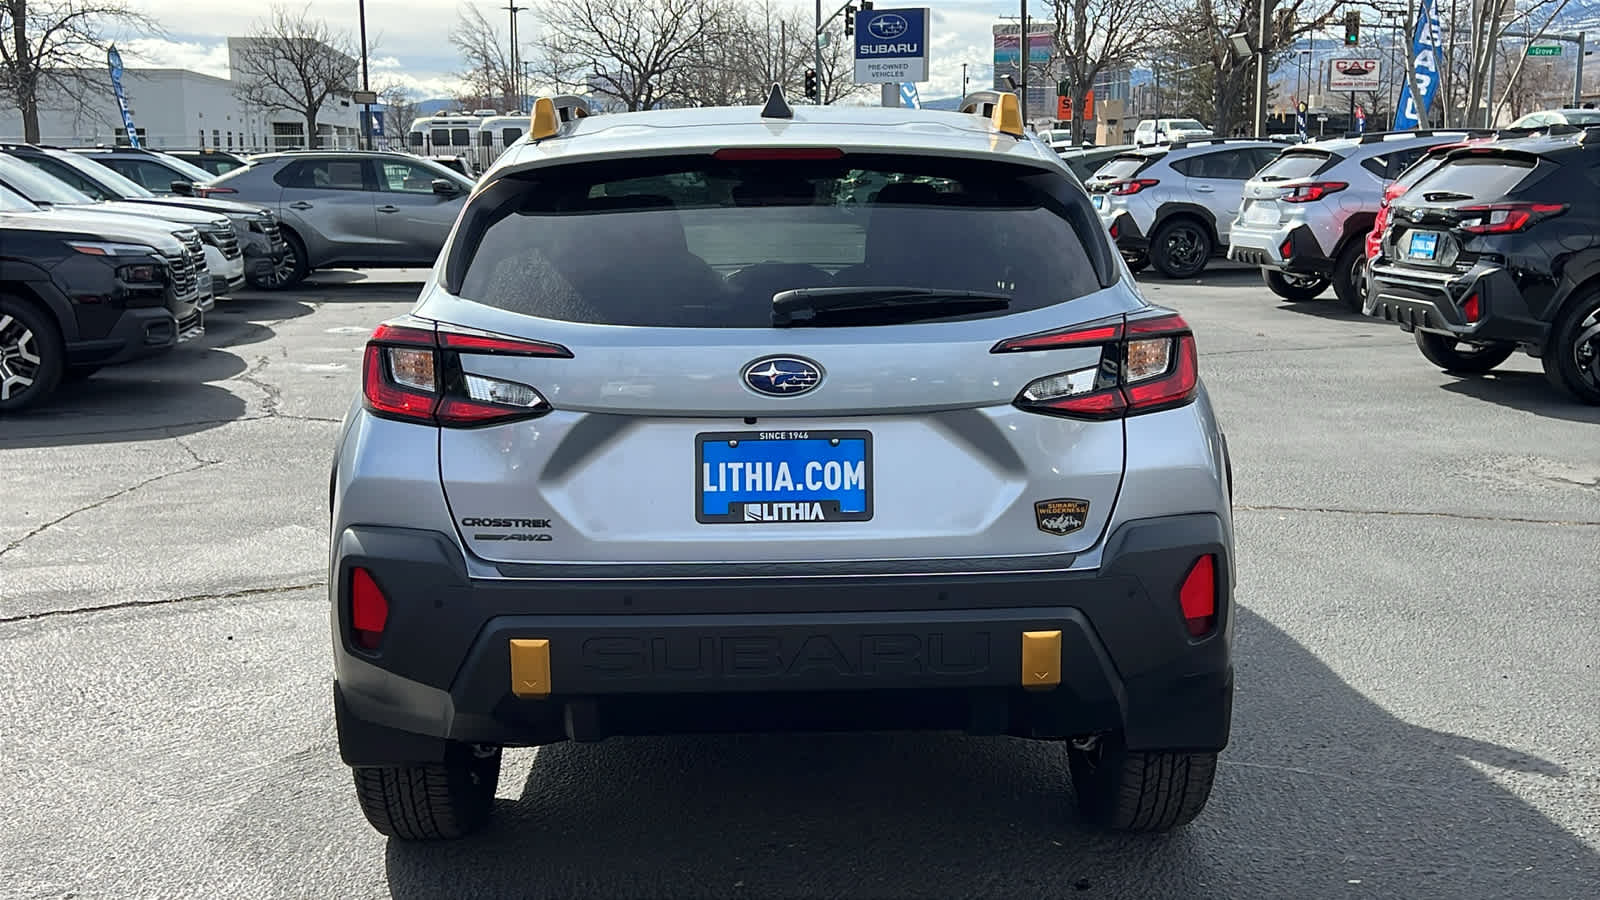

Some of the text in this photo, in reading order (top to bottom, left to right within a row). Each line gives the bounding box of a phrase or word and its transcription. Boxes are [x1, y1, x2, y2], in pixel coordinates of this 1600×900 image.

[860, 43, 917, 54] SUBARU
[1336, 60, 1376, 72] CAC
[759, 432, 809, 440] SINCE 1946
[703, 461, 865, 491] LITHIA.COM
[761, 502, 825, 521] LITHIA
[461, 517, 552, 528] CROSSTREK
[582, 632, 991, 678] SUBARU
